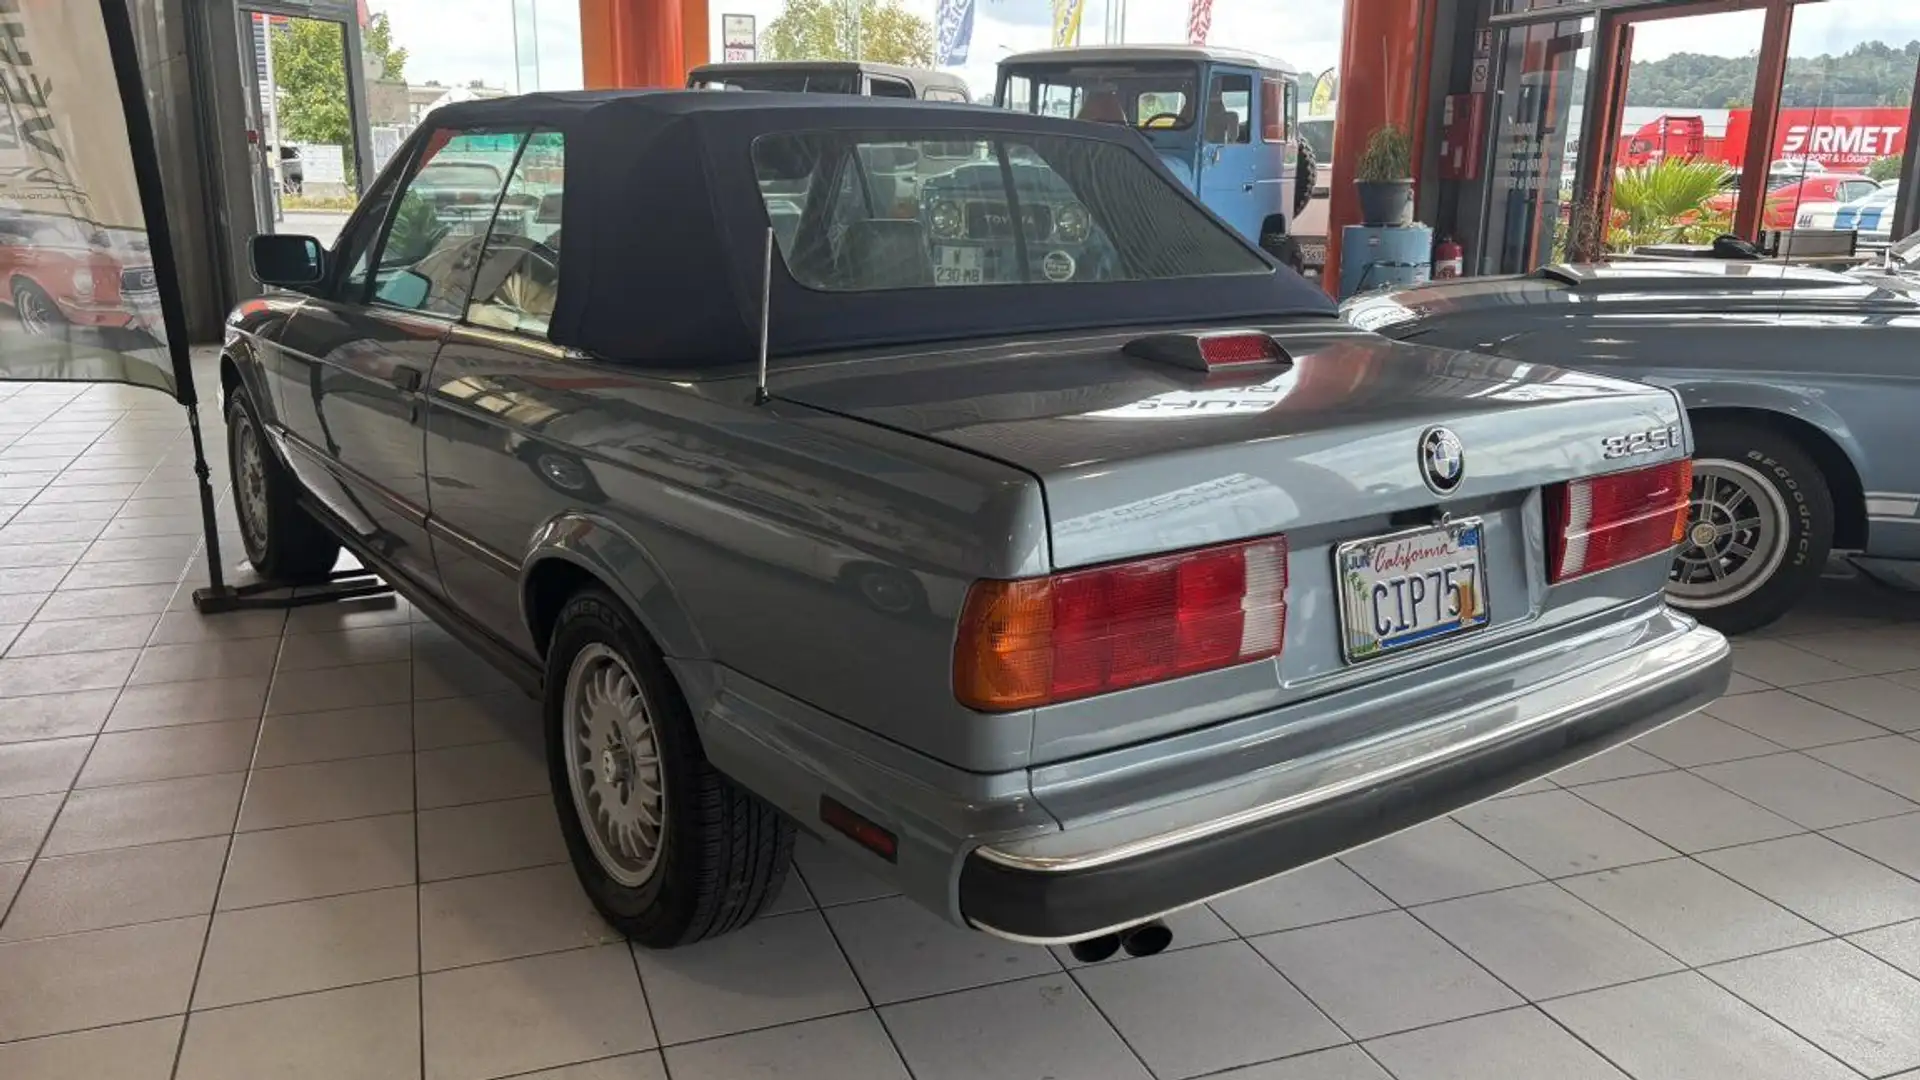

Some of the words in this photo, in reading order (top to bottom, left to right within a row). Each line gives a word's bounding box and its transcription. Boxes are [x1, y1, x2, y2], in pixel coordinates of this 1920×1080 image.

[983, 213, 1035, 225] TOYTA
[1602, 427, 1680, 459] 325i
[1374, 541, 1456, 573] California
[1373, 562, 1477, 637] CIP757
